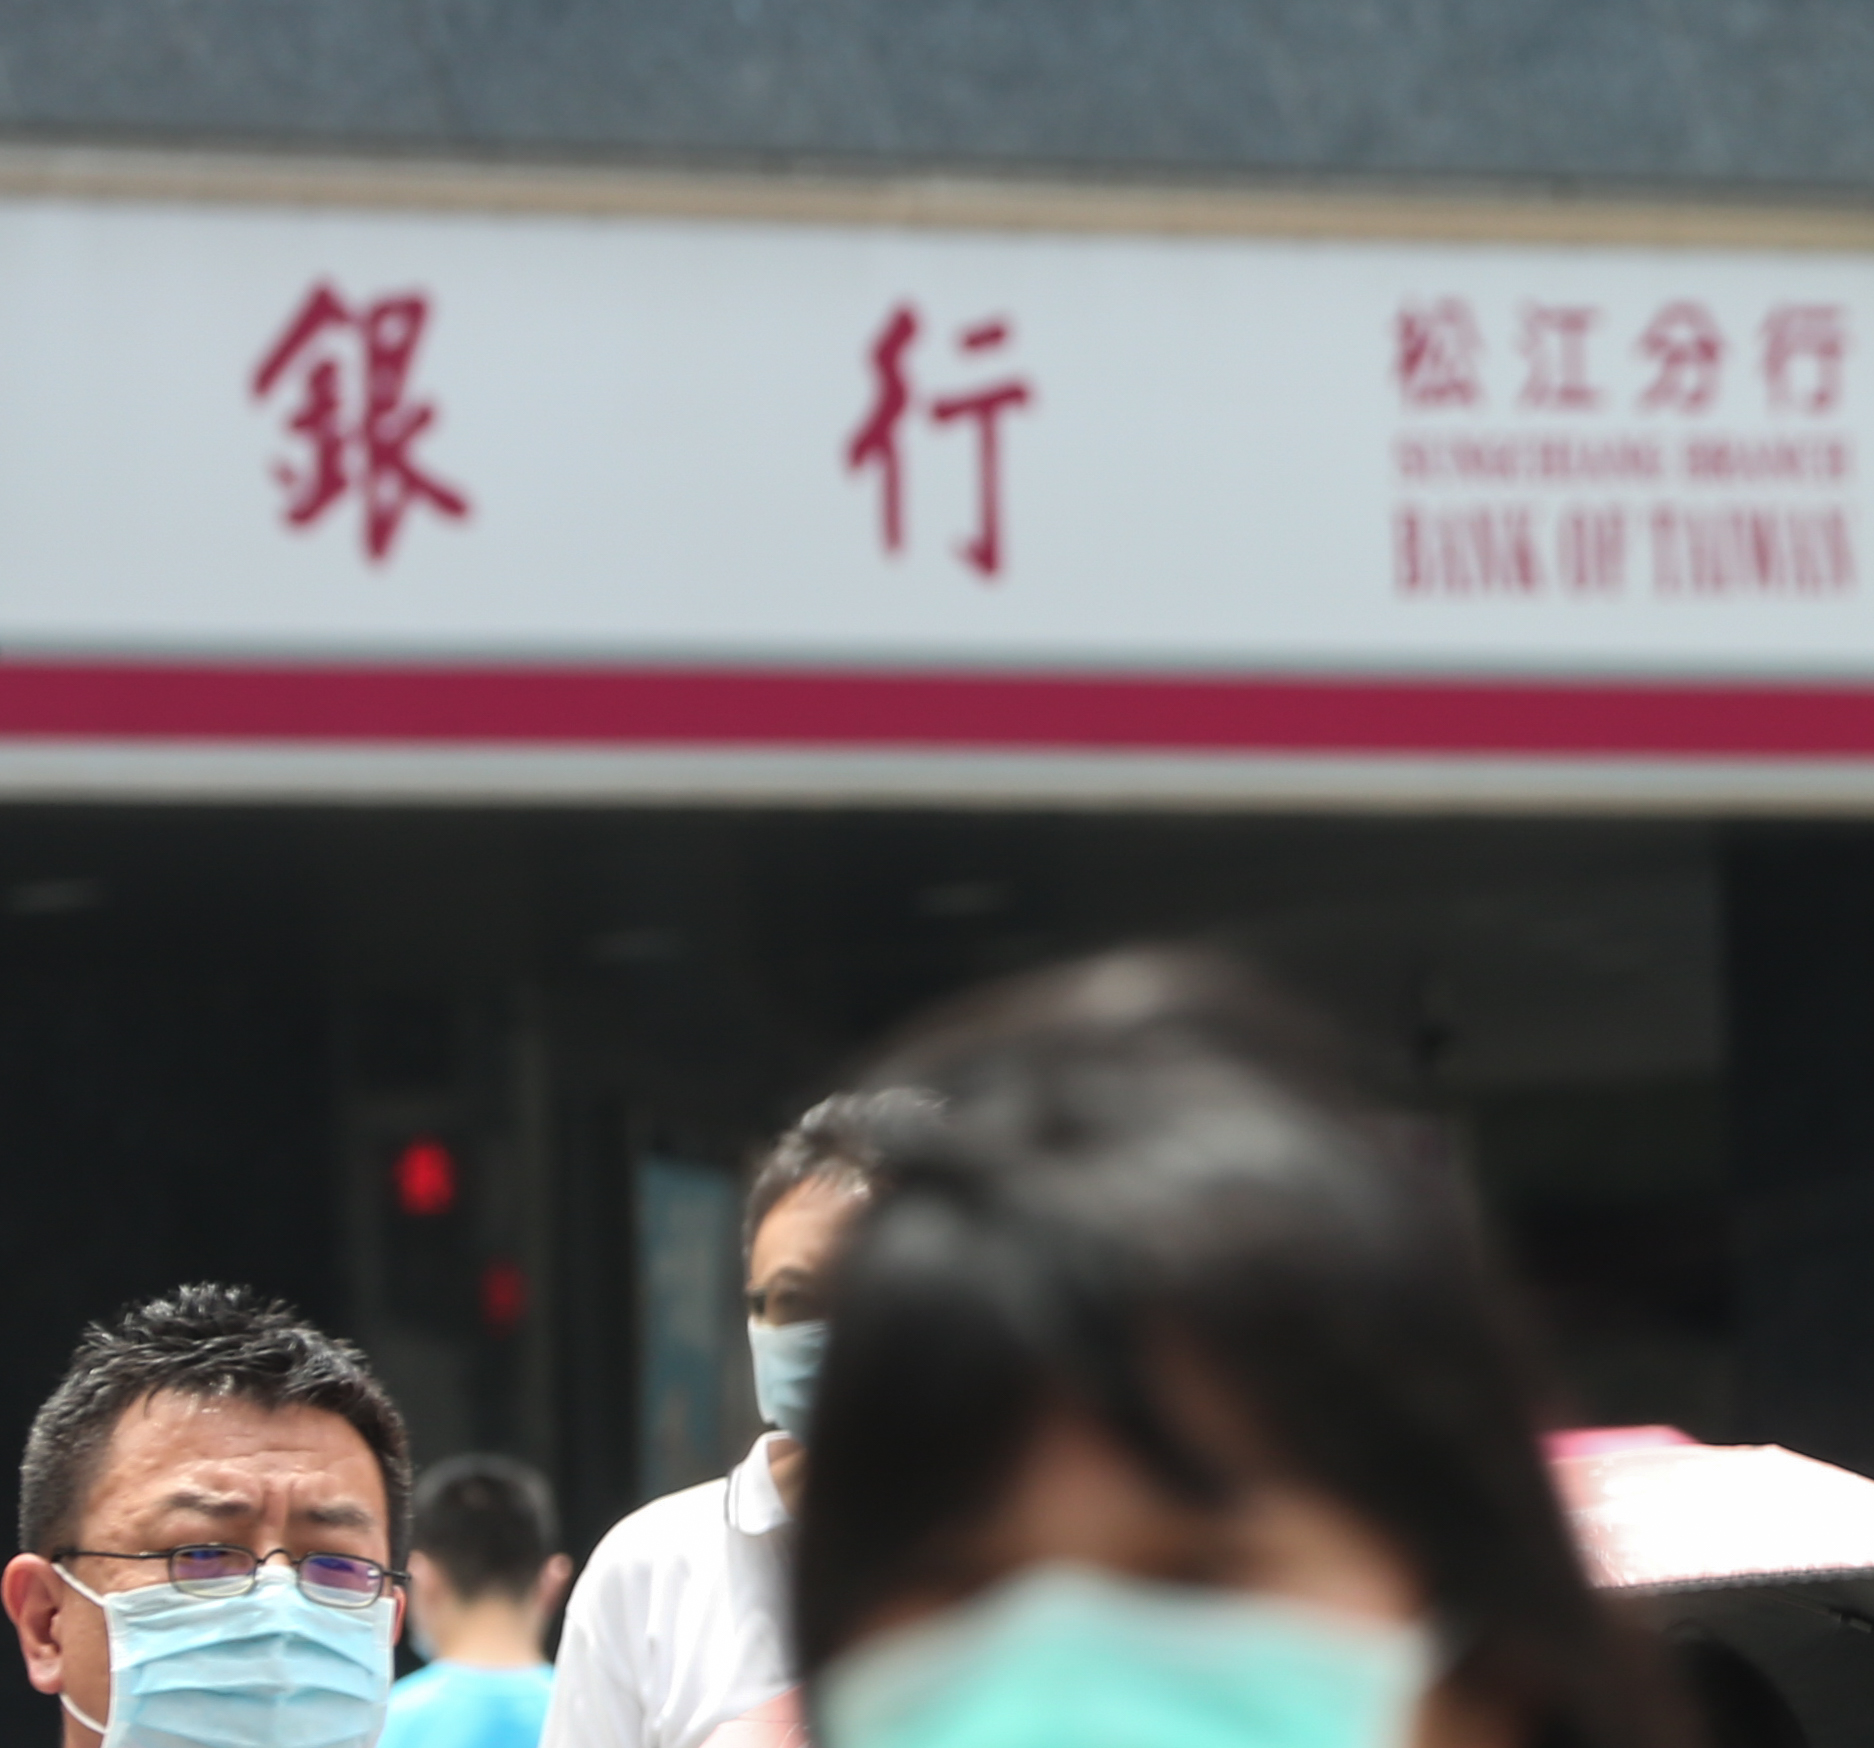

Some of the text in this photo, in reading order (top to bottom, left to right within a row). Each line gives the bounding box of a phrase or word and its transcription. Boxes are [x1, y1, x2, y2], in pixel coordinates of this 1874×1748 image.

[1393, 298, 1848, 412] 松江分行
[1394, 506, 1856, 592] BANK OF TAIWAN
